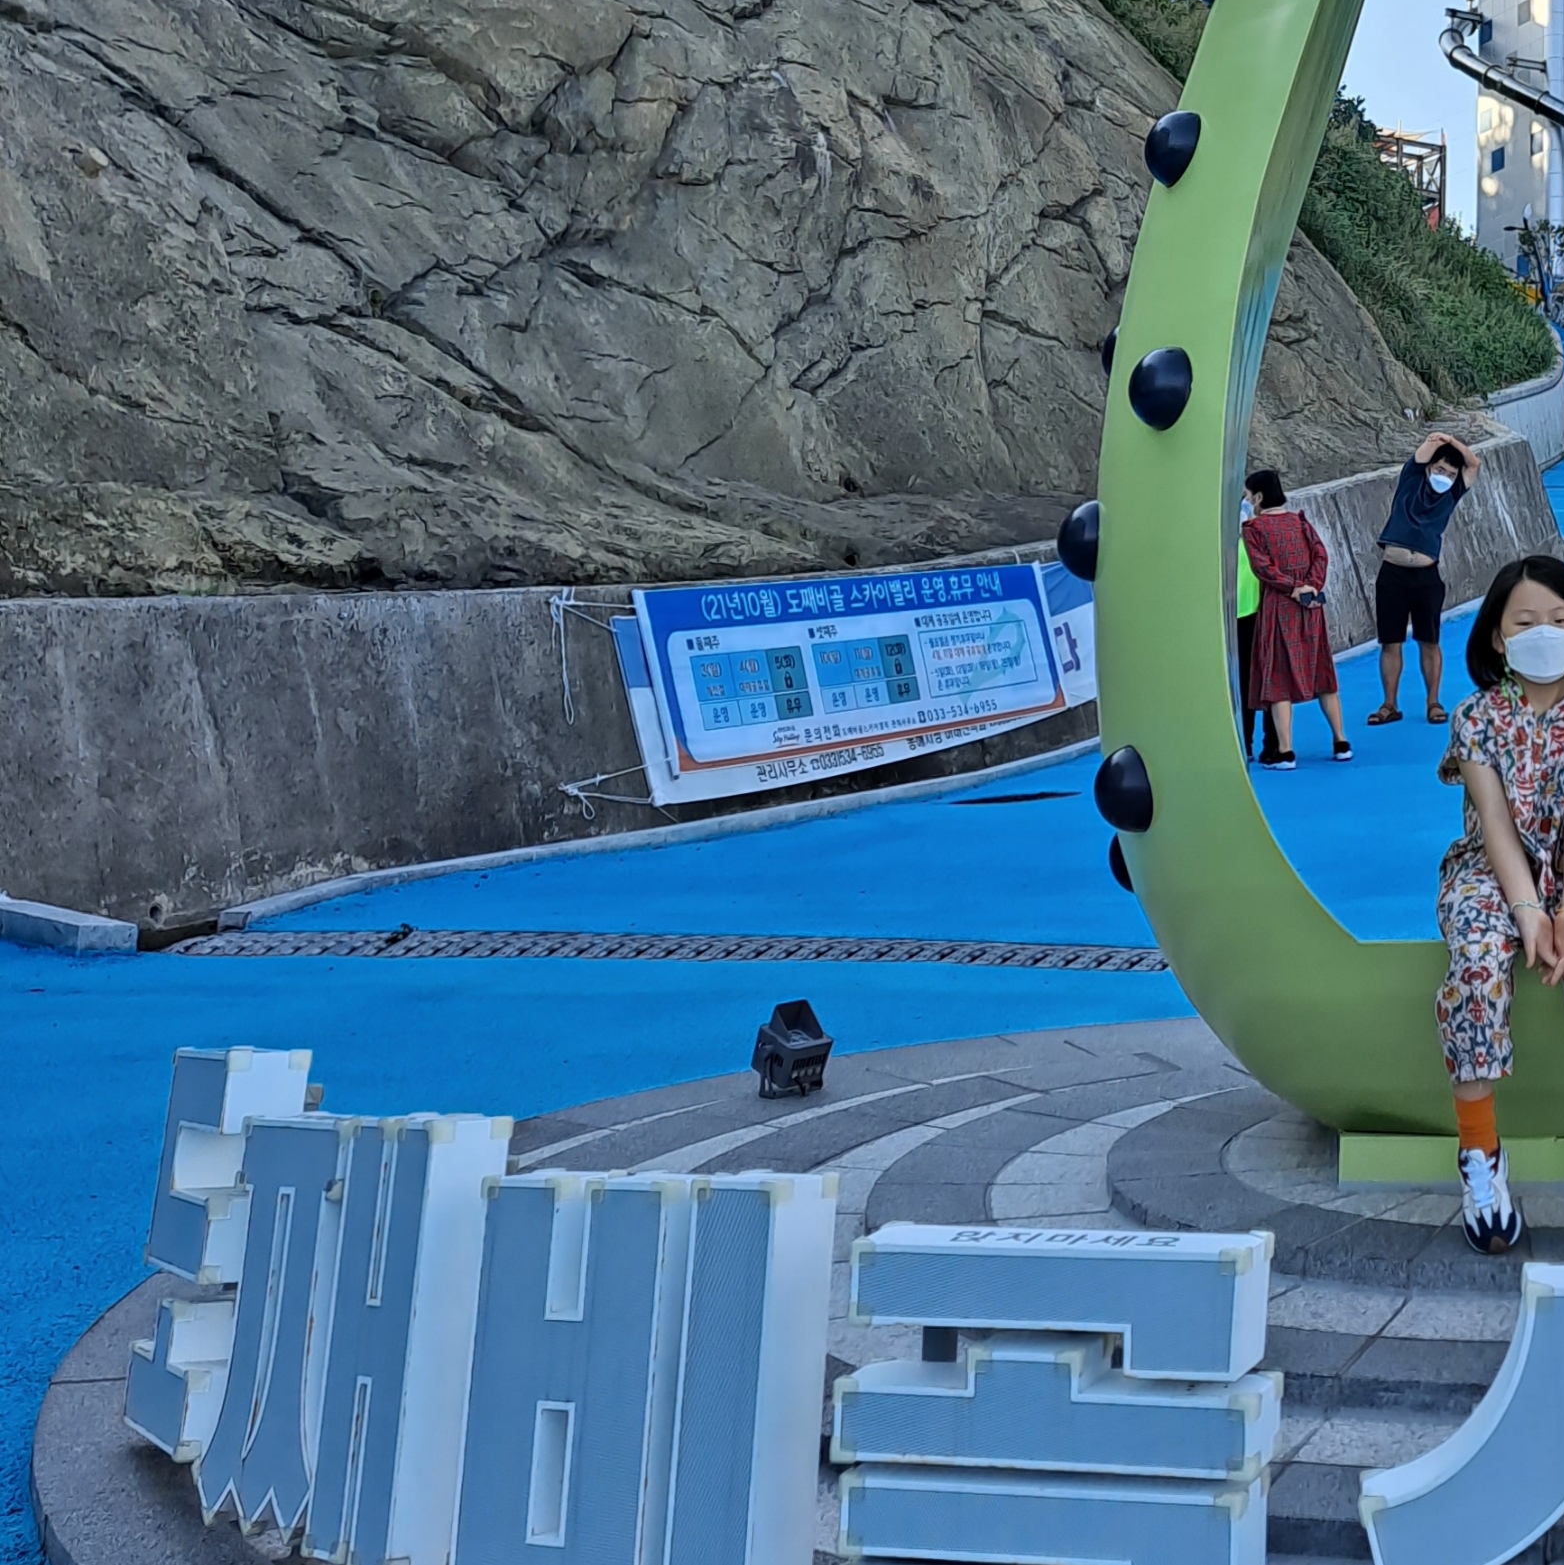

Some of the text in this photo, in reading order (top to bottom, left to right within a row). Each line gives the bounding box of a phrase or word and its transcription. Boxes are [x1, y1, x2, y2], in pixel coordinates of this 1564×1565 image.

[700, 590, 782, 621] (21년10월)
[785, 586, 845, 614] 도째비골
[847, 580, 916, 608] 스카이밸리
[977, 573, 1001, 596] 안내
[803, 724, 840, 742] 문의전화
[926, 699, 997, 721] 033-534-6955
[756, 760, 809, 783] 관리사무소
